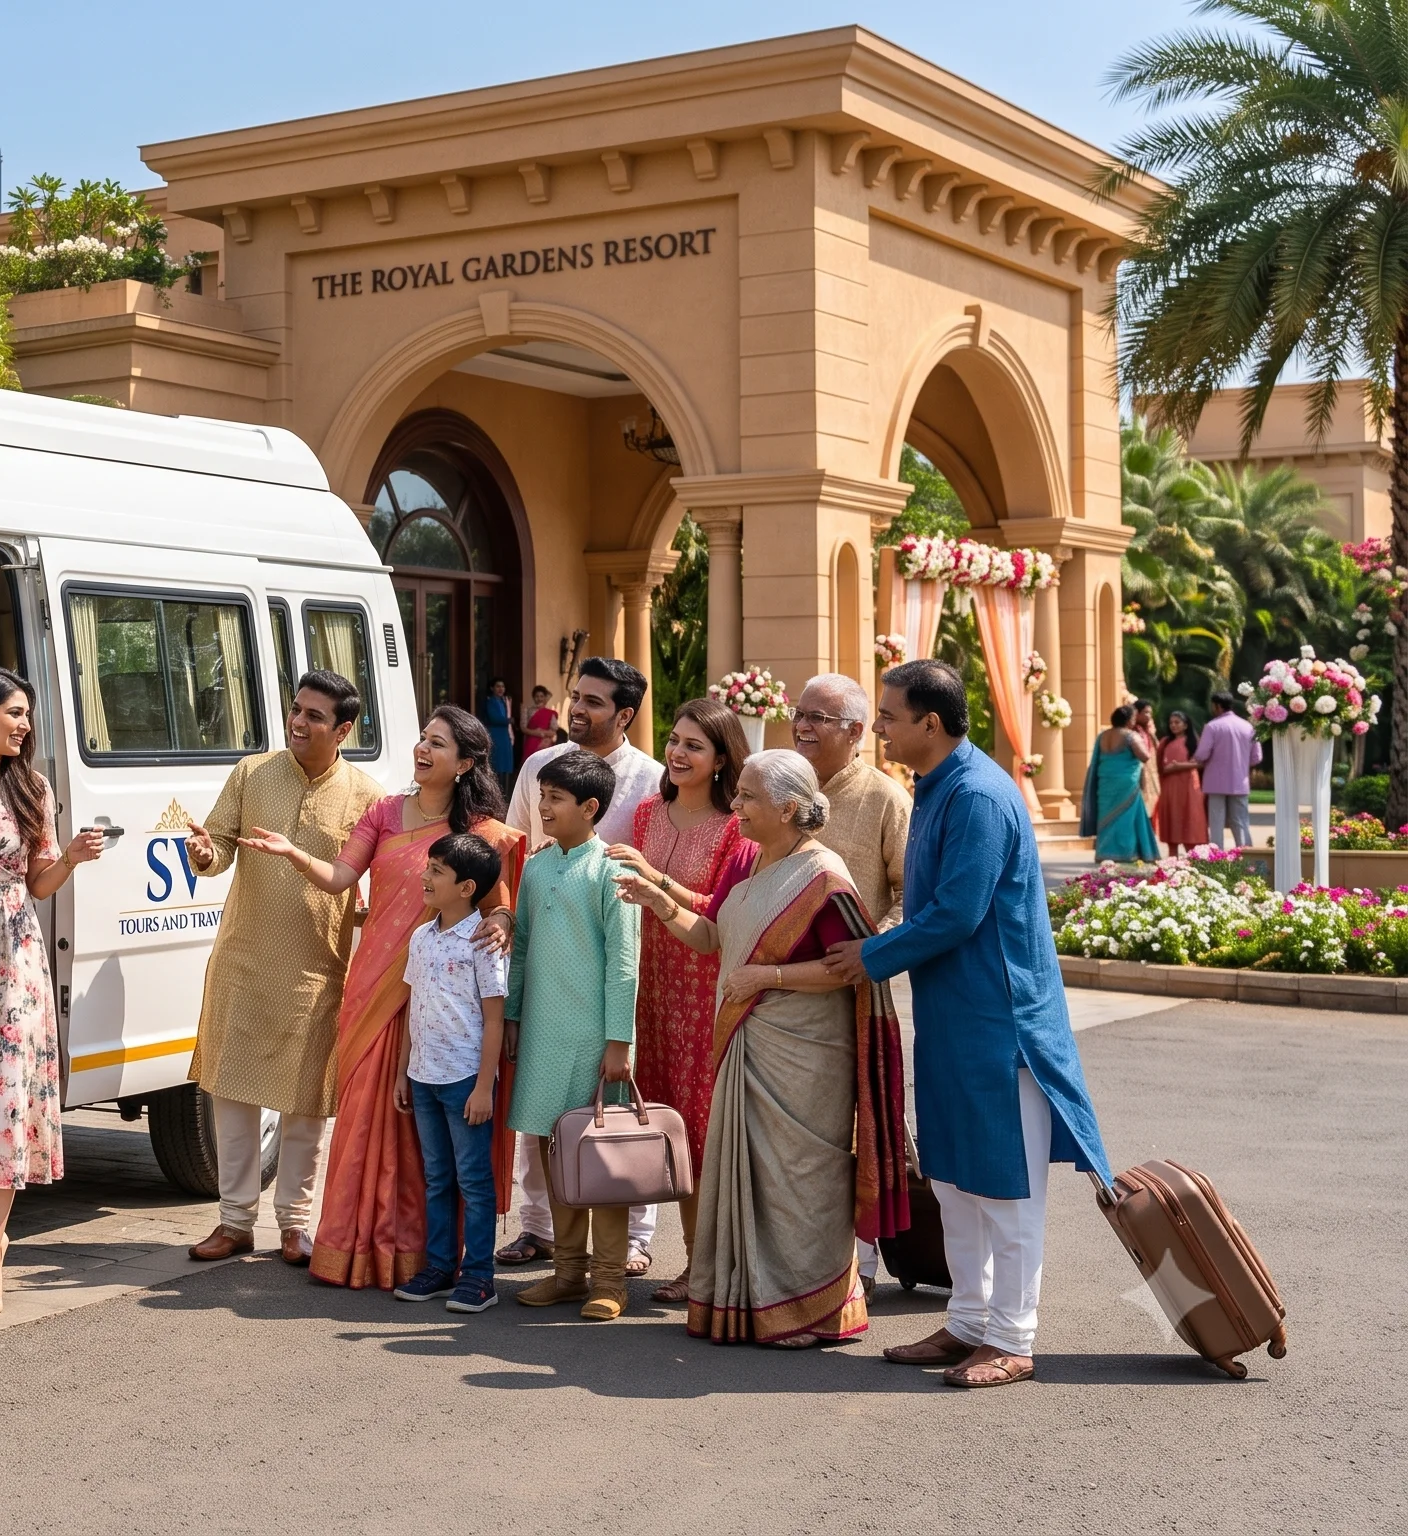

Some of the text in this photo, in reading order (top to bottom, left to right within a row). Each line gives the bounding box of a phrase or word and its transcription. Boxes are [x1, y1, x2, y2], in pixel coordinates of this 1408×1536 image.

[312, 228, 717, 300] THE ROYAL GARDENS RESORT
[119, 916, 159, 935] TOURS
[161, 914, 188, 930] AND
